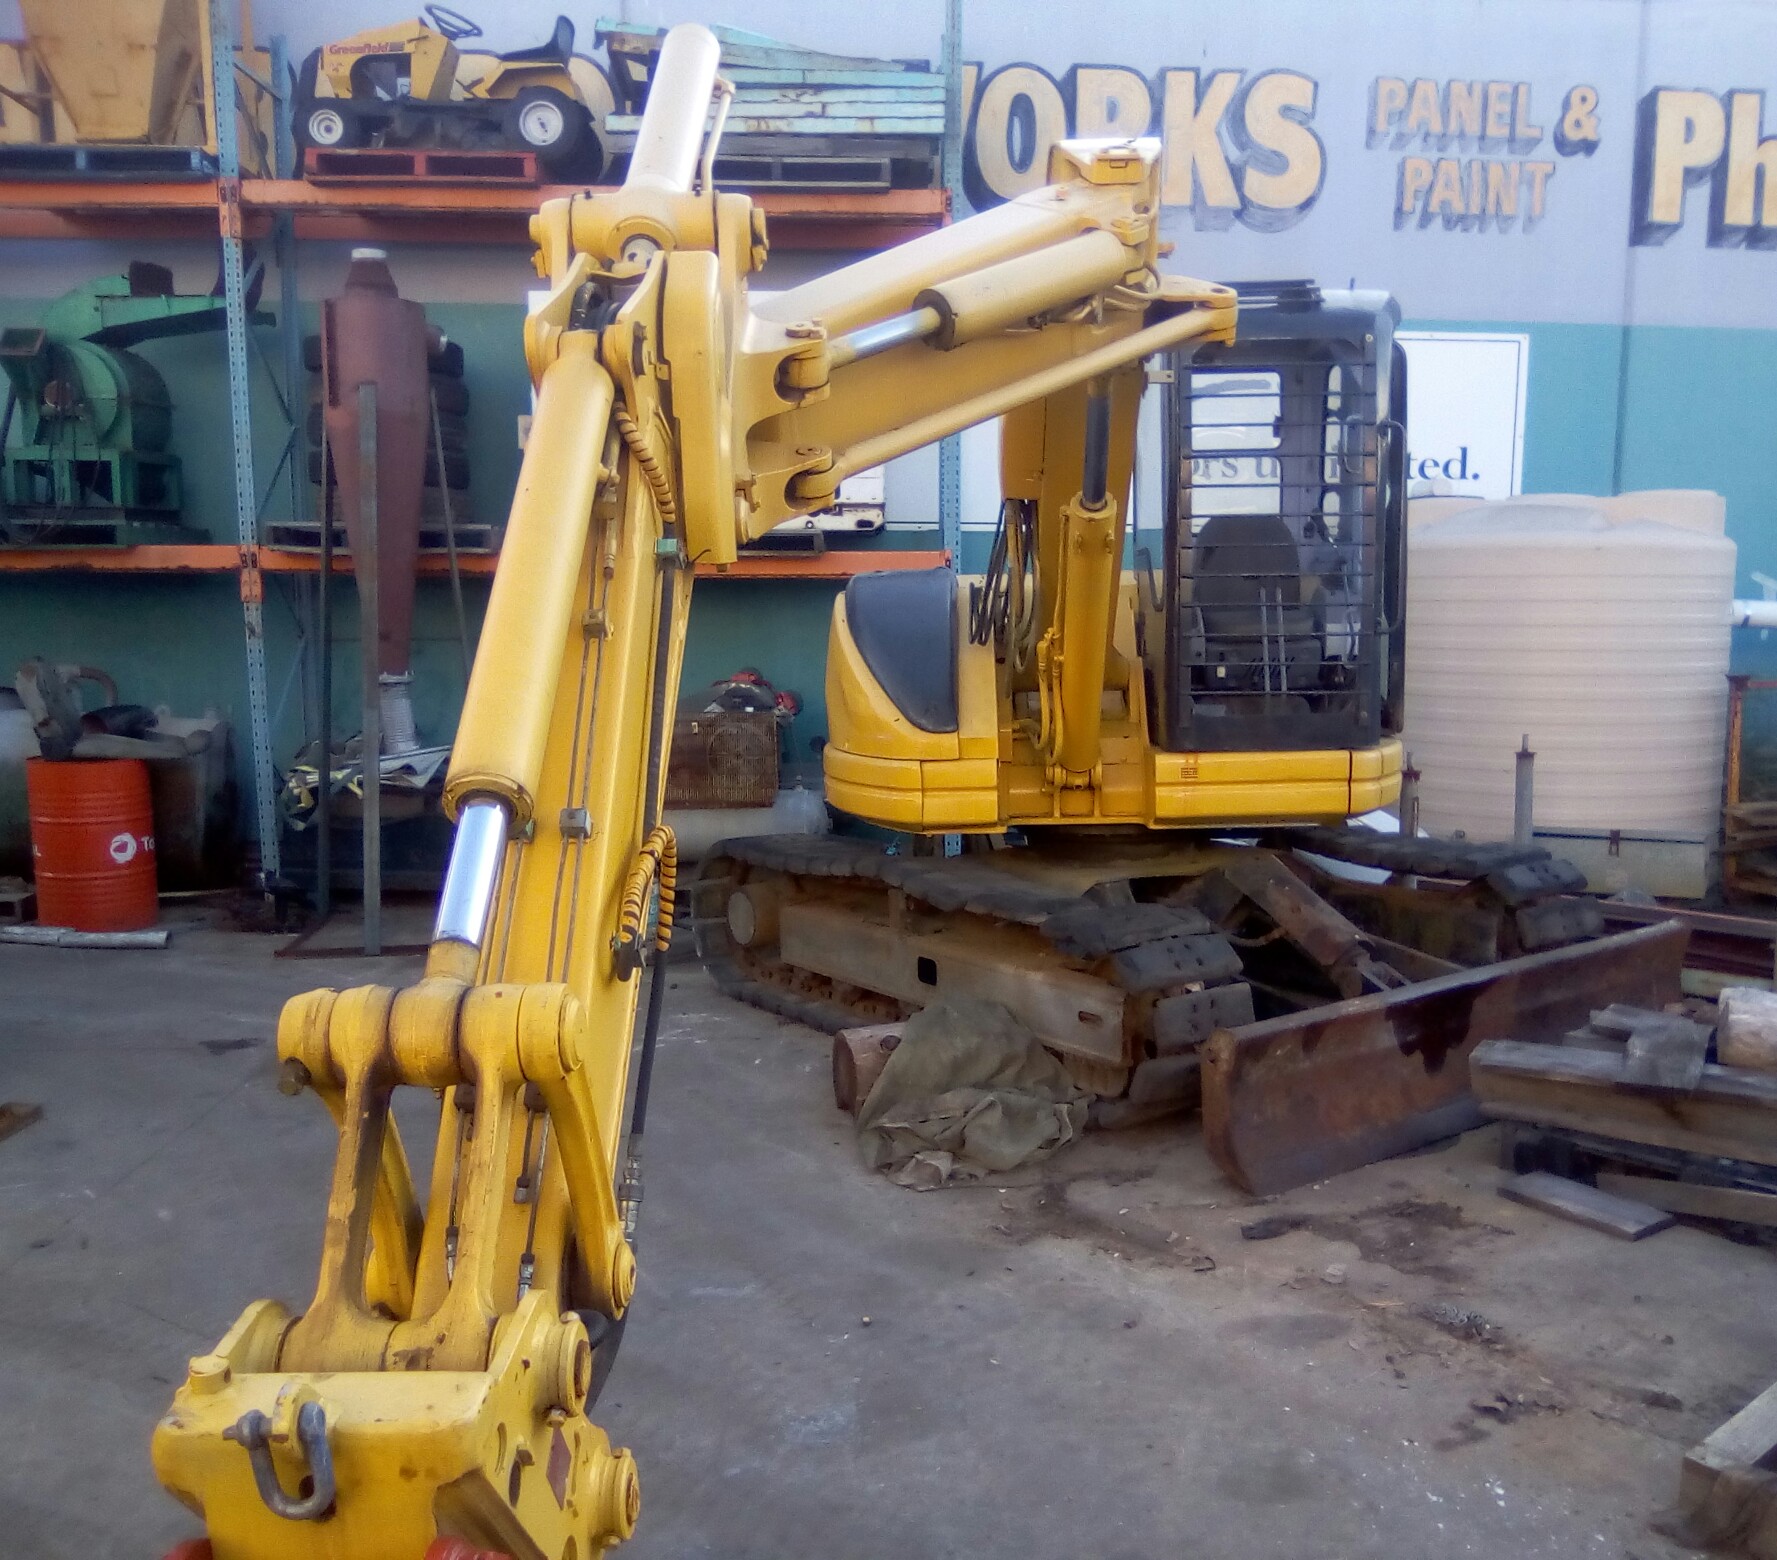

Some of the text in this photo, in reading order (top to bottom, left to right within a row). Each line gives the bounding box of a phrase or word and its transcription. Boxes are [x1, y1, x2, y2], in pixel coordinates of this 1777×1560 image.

[960, 62, 1325, 222] ORKS
[1371, 75, 1600, 151] PANEL &
[1397, 155, 1556, 224] PAINT
